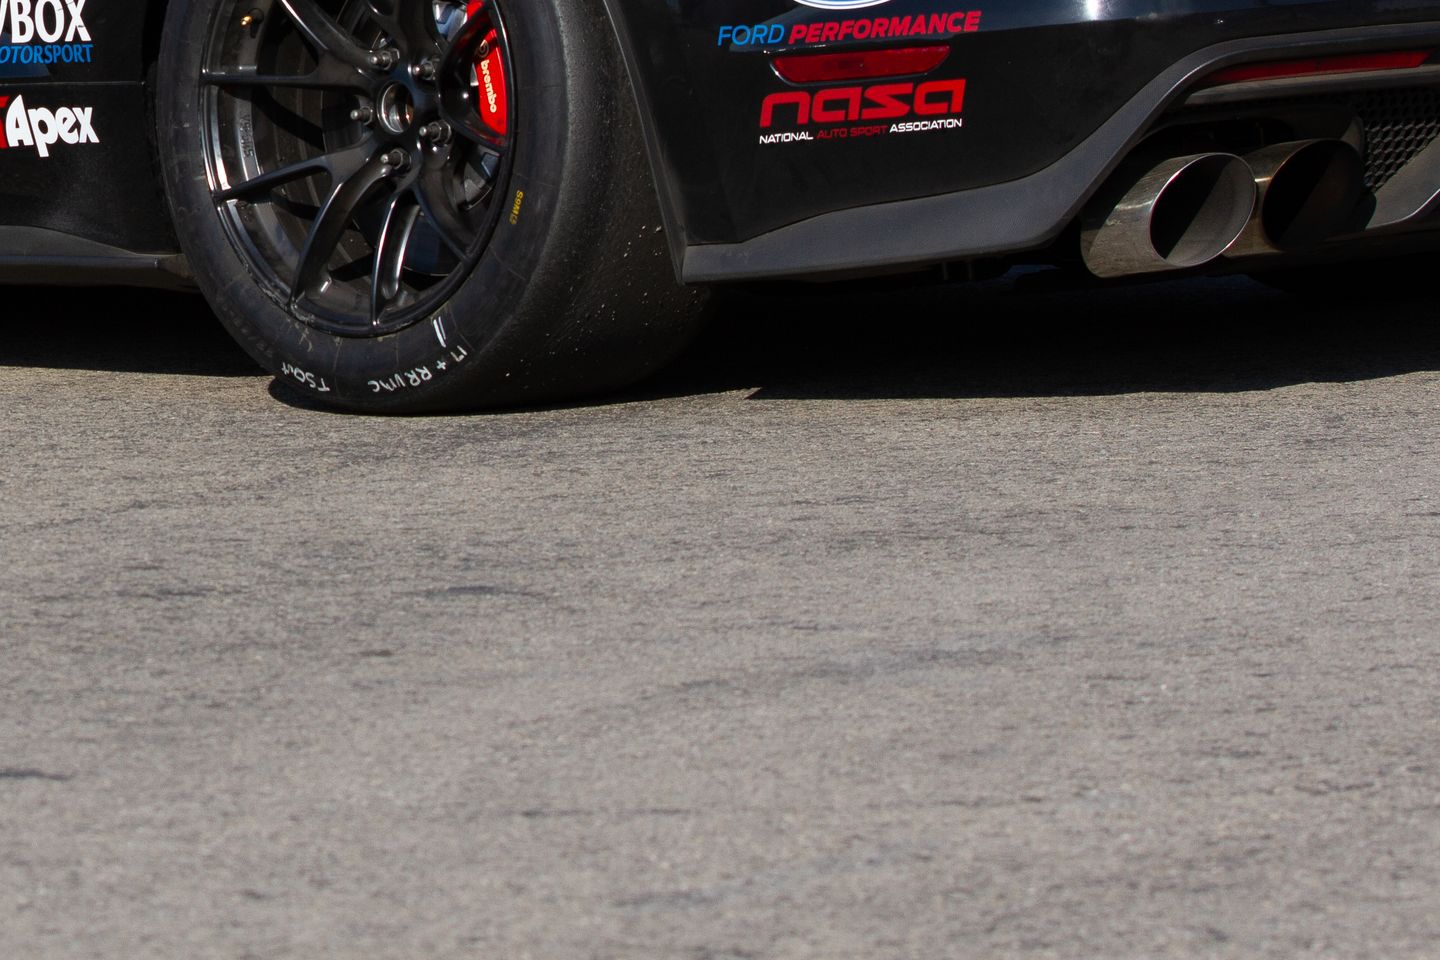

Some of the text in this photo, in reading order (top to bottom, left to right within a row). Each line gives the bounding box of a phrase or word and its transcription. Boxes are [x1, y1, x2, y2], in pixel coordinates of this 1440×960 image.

[717, 10, 982, 46] FORD PERFORMANCE
[480, 58, 498, 114] brembo
[760, 78, 966, 128] nasa
[759, 118, 962, 144] NATIONAL AUTO SPORT ASSOCIATION
